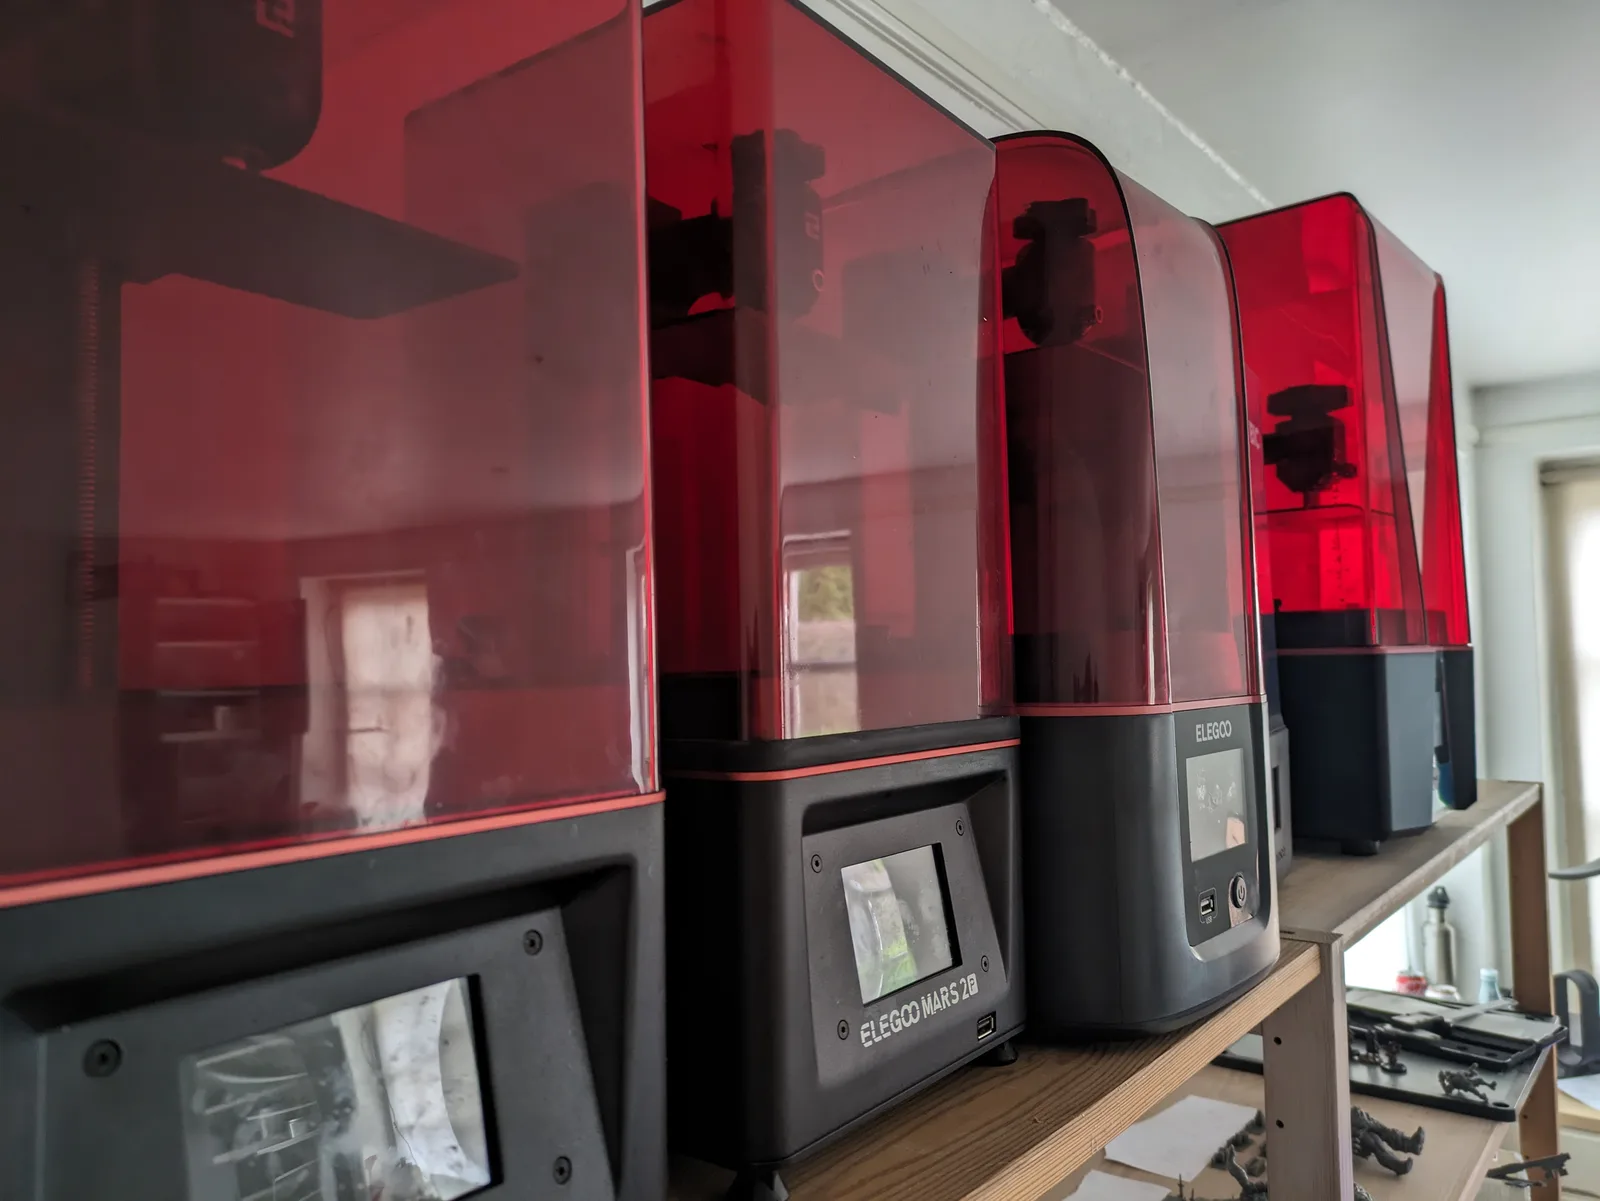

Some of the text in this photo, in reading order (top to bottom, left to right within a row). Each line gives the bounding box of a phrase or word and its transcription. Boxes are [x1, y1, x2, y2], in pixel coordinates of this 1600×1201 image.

[1196, 720, 1232, 742] ELEGOO
[860, 1000, 920, 1048] ELEGOO
[921, 981, 959, 1018] MARS
